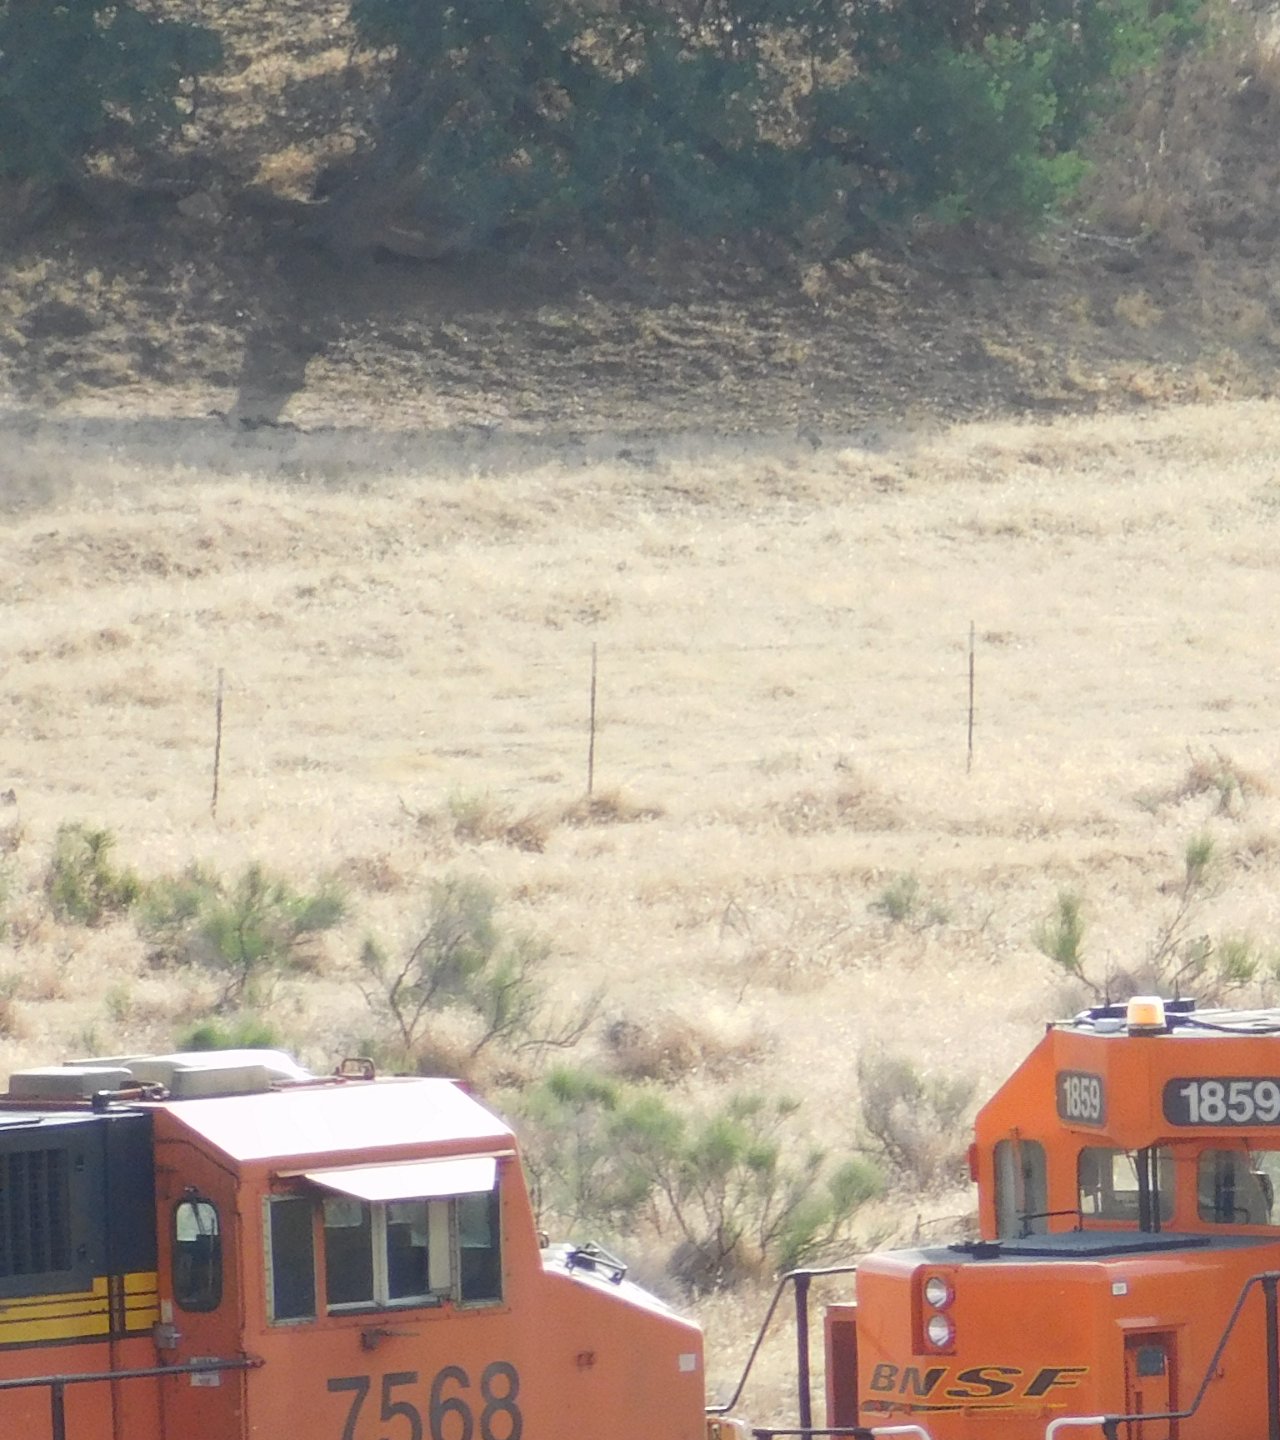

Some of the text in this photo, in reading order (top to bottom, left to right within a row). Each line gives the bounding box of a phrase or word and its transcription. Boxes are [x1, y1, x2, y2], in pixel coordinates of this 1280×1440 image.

[1063, 1076, 1100, 1119] 1859
[1180, 1080, 1280, 1123] 1859
[869, 1363, 1089, 1399] BNSF
